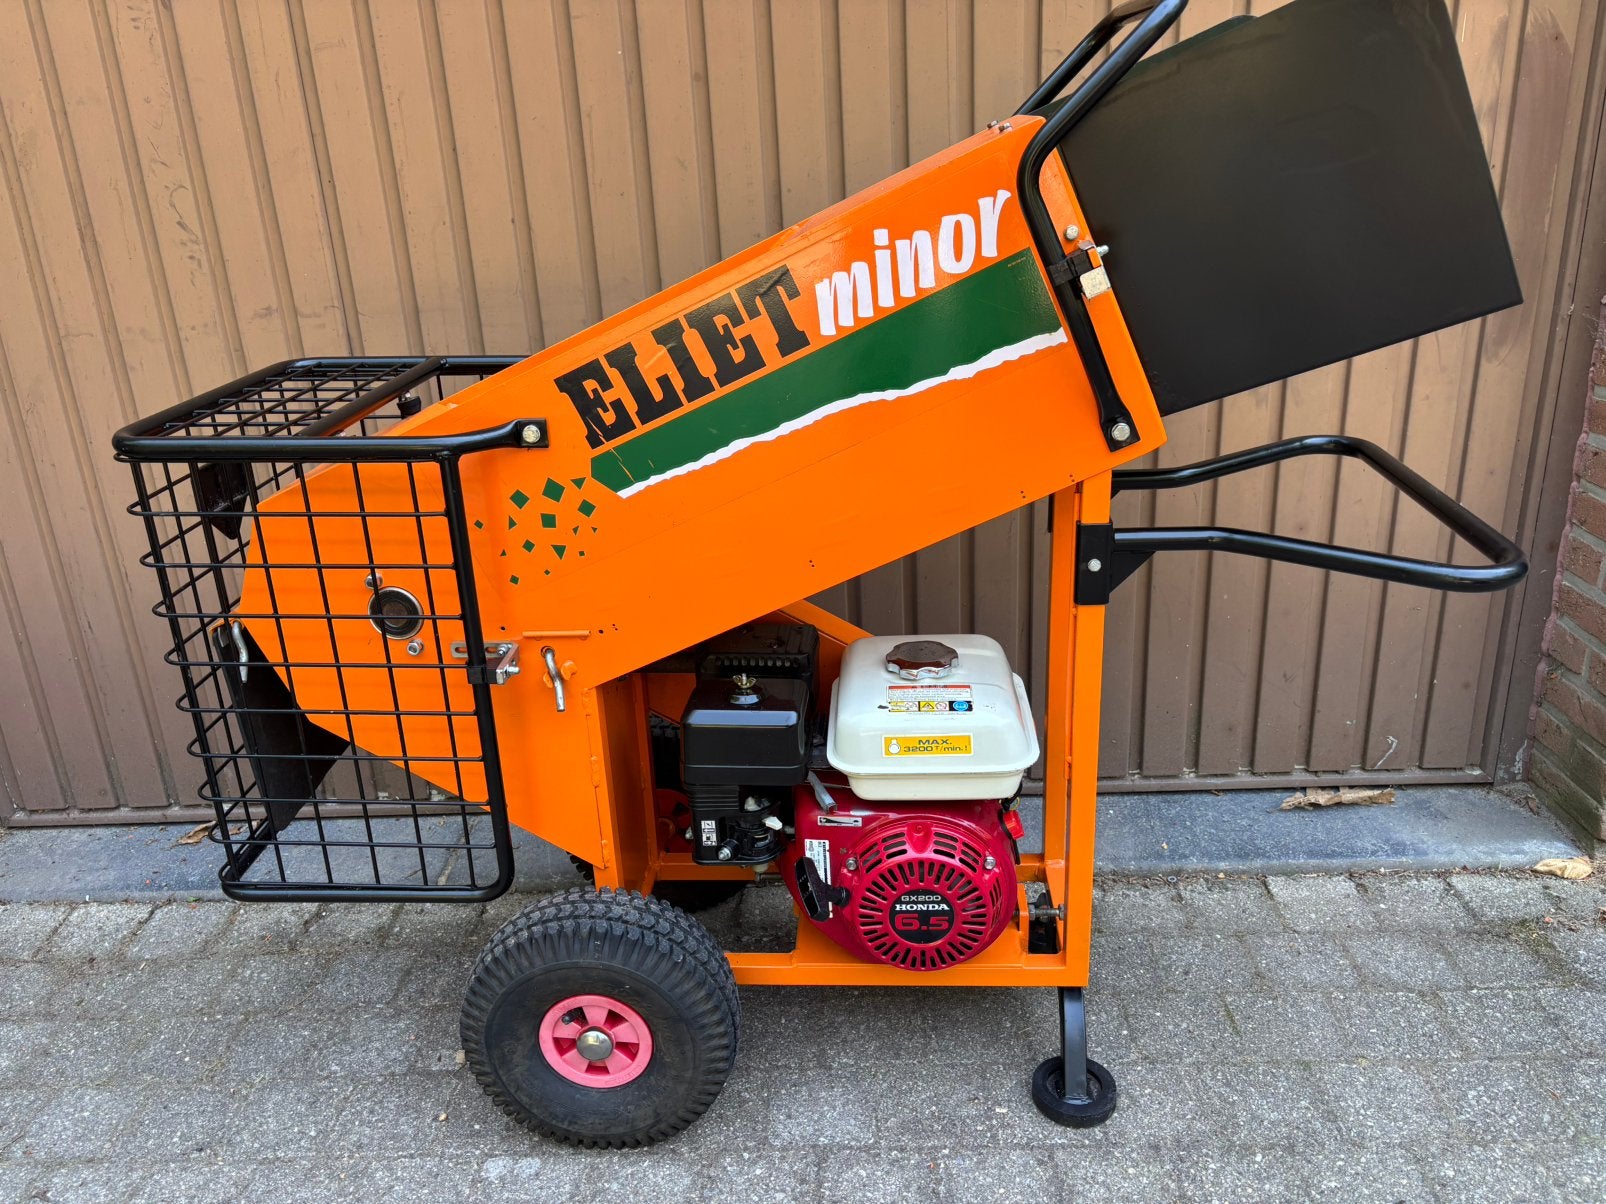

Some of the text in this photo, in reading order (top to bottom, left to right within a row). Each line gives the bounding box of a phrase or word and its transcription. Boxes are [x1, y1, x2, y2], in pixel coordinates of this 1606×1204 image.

[554, 190, 1011, 449] ELIET minor
[895, 903, 950, 911] HONDA
[895, 913, 949, 931] 6.5
